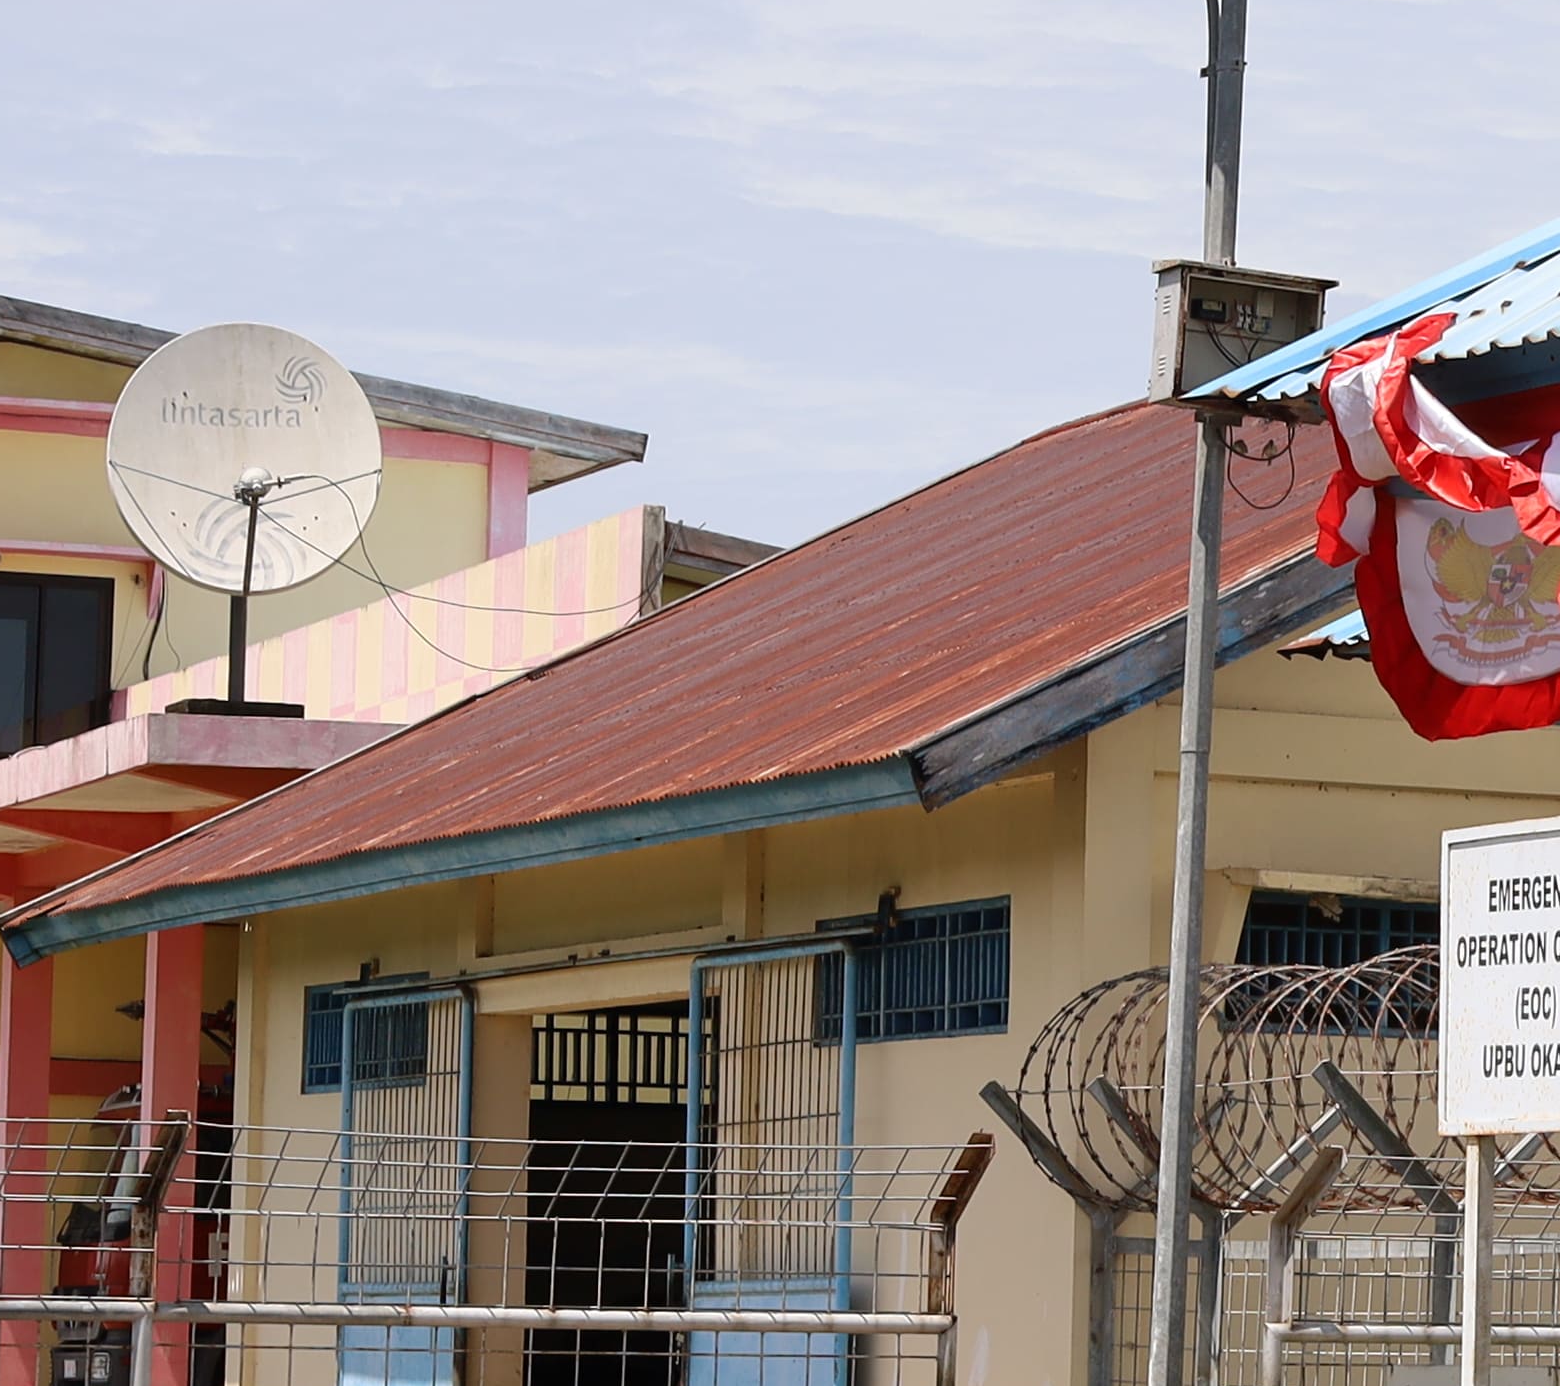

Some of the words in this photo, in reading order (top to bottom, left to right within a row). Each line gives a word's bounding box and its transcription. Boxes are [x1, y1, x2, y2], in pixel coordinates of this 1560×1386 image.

[162, 398, 302, 427] lintasarta
[1457, 931, 1547, 967] OPERATION
[1515, 986, 1558, 1029] (EOC)
[1483, 1044, 1526, 1078] UPBU
